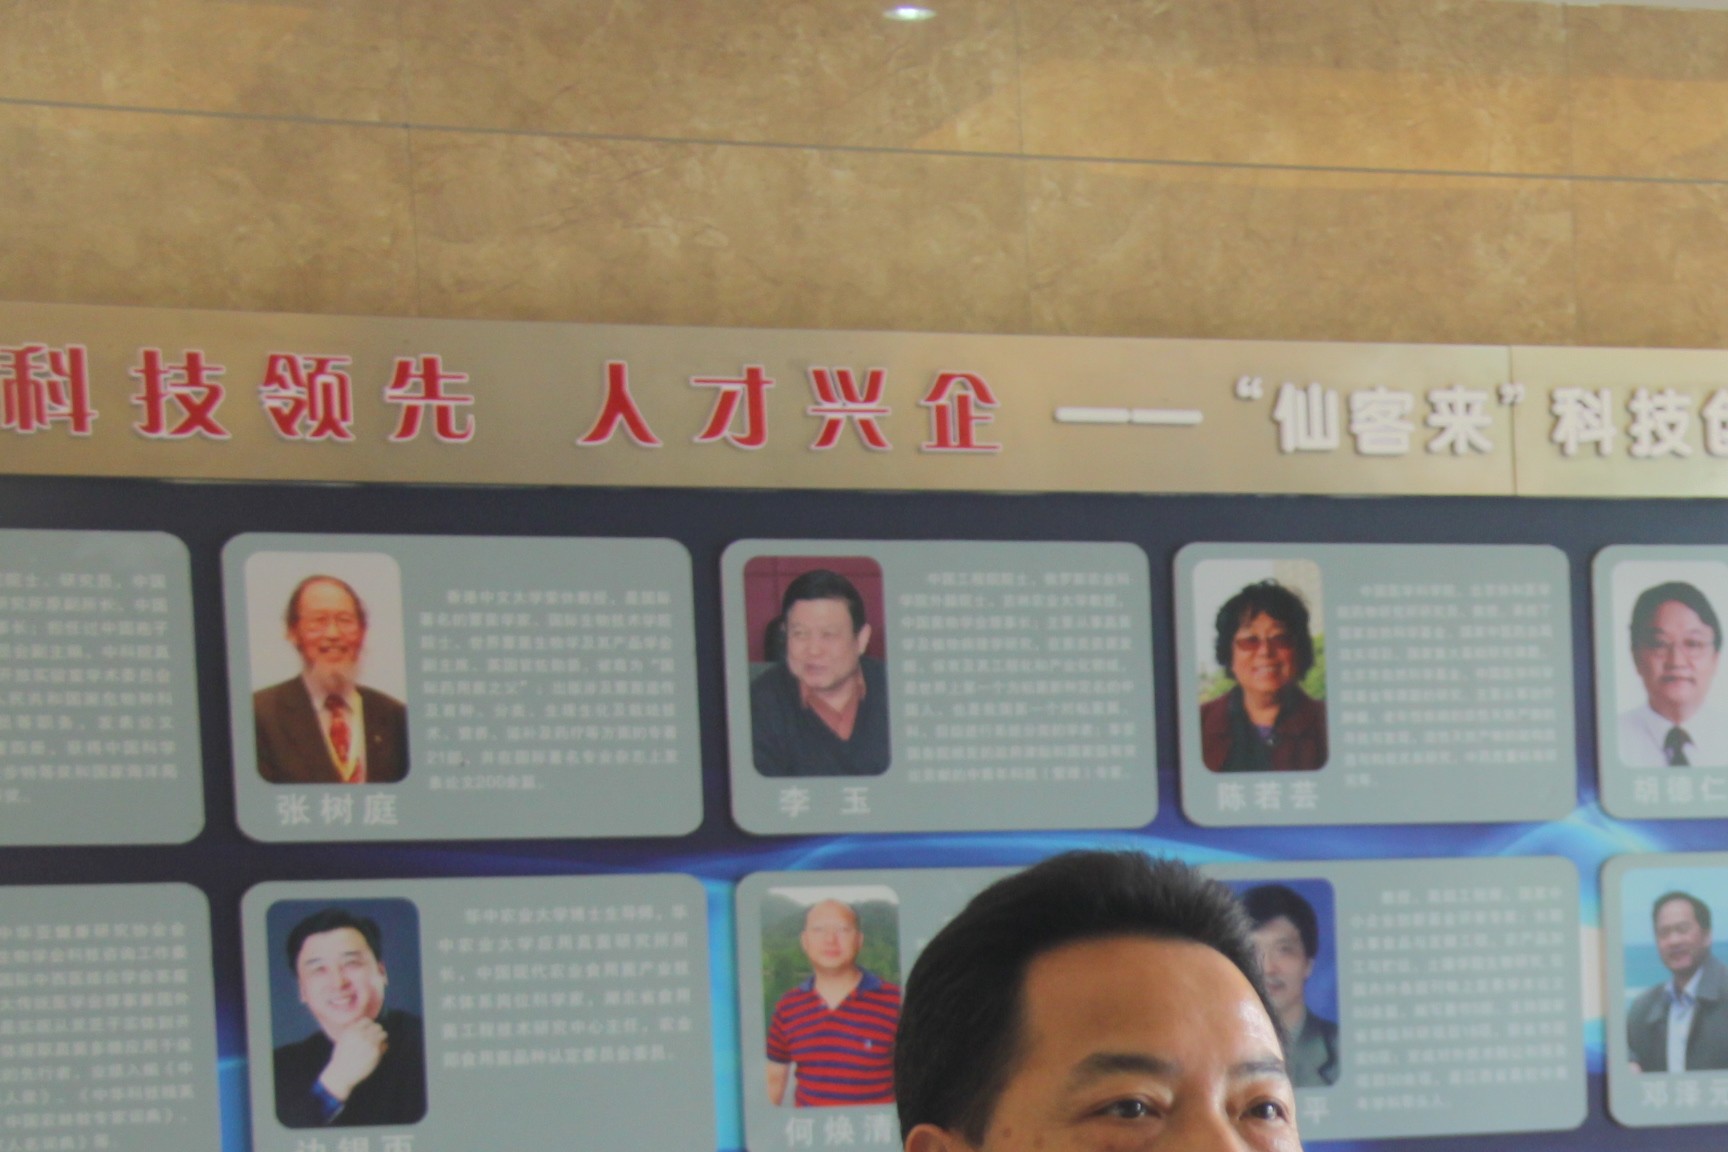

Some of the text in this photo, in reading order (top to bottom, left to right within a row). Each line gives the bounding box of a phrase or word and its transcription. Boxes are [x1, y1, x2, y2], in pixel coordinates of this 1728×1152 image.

[0, 344, 474, 443] 科技领先
[577, 360, 1001, 455] 人才兴企
[275, 792, 400, 827] 张树庭
[779, 786, 872, 819] 李玉
